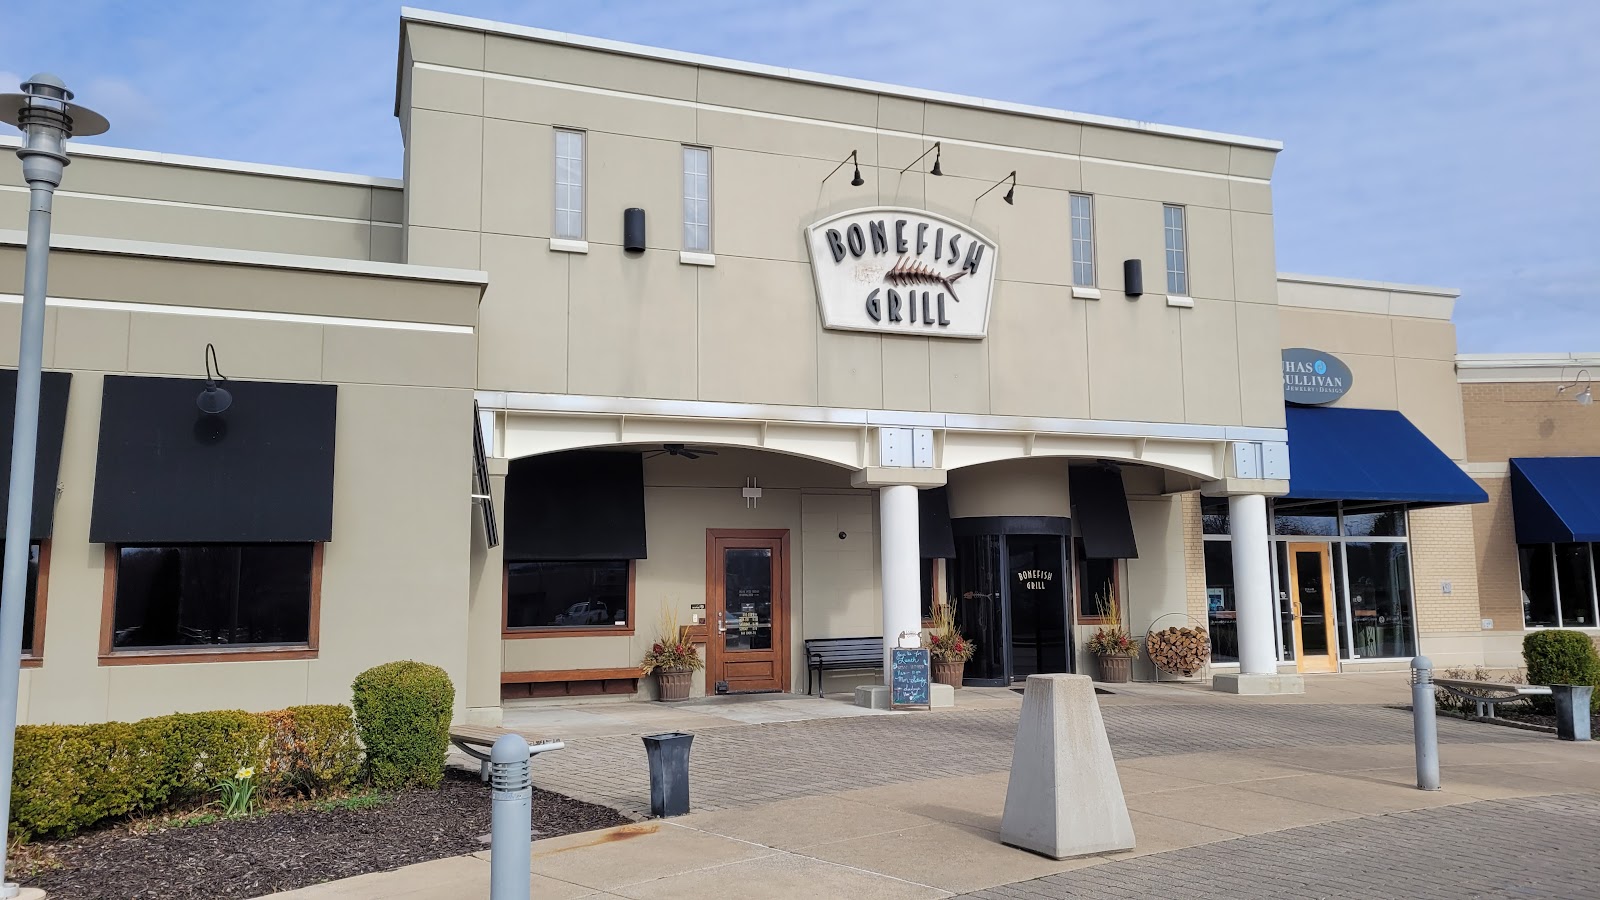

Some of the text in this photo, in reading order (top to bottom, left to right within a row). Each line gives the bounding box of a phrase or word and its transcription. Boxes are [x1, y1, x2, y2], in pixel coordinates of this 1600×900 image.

[826, 219, 985, 275] BONEFISH
[866, 288, 950, 326] GRILL
[1282, 361, 1313, 373] HAS
[1283, 375, 1342, 387] ULLIVAN
[1018, 570, 1053, 581] BONEFISH
[1026, 581, 1045, 590] GRILL
